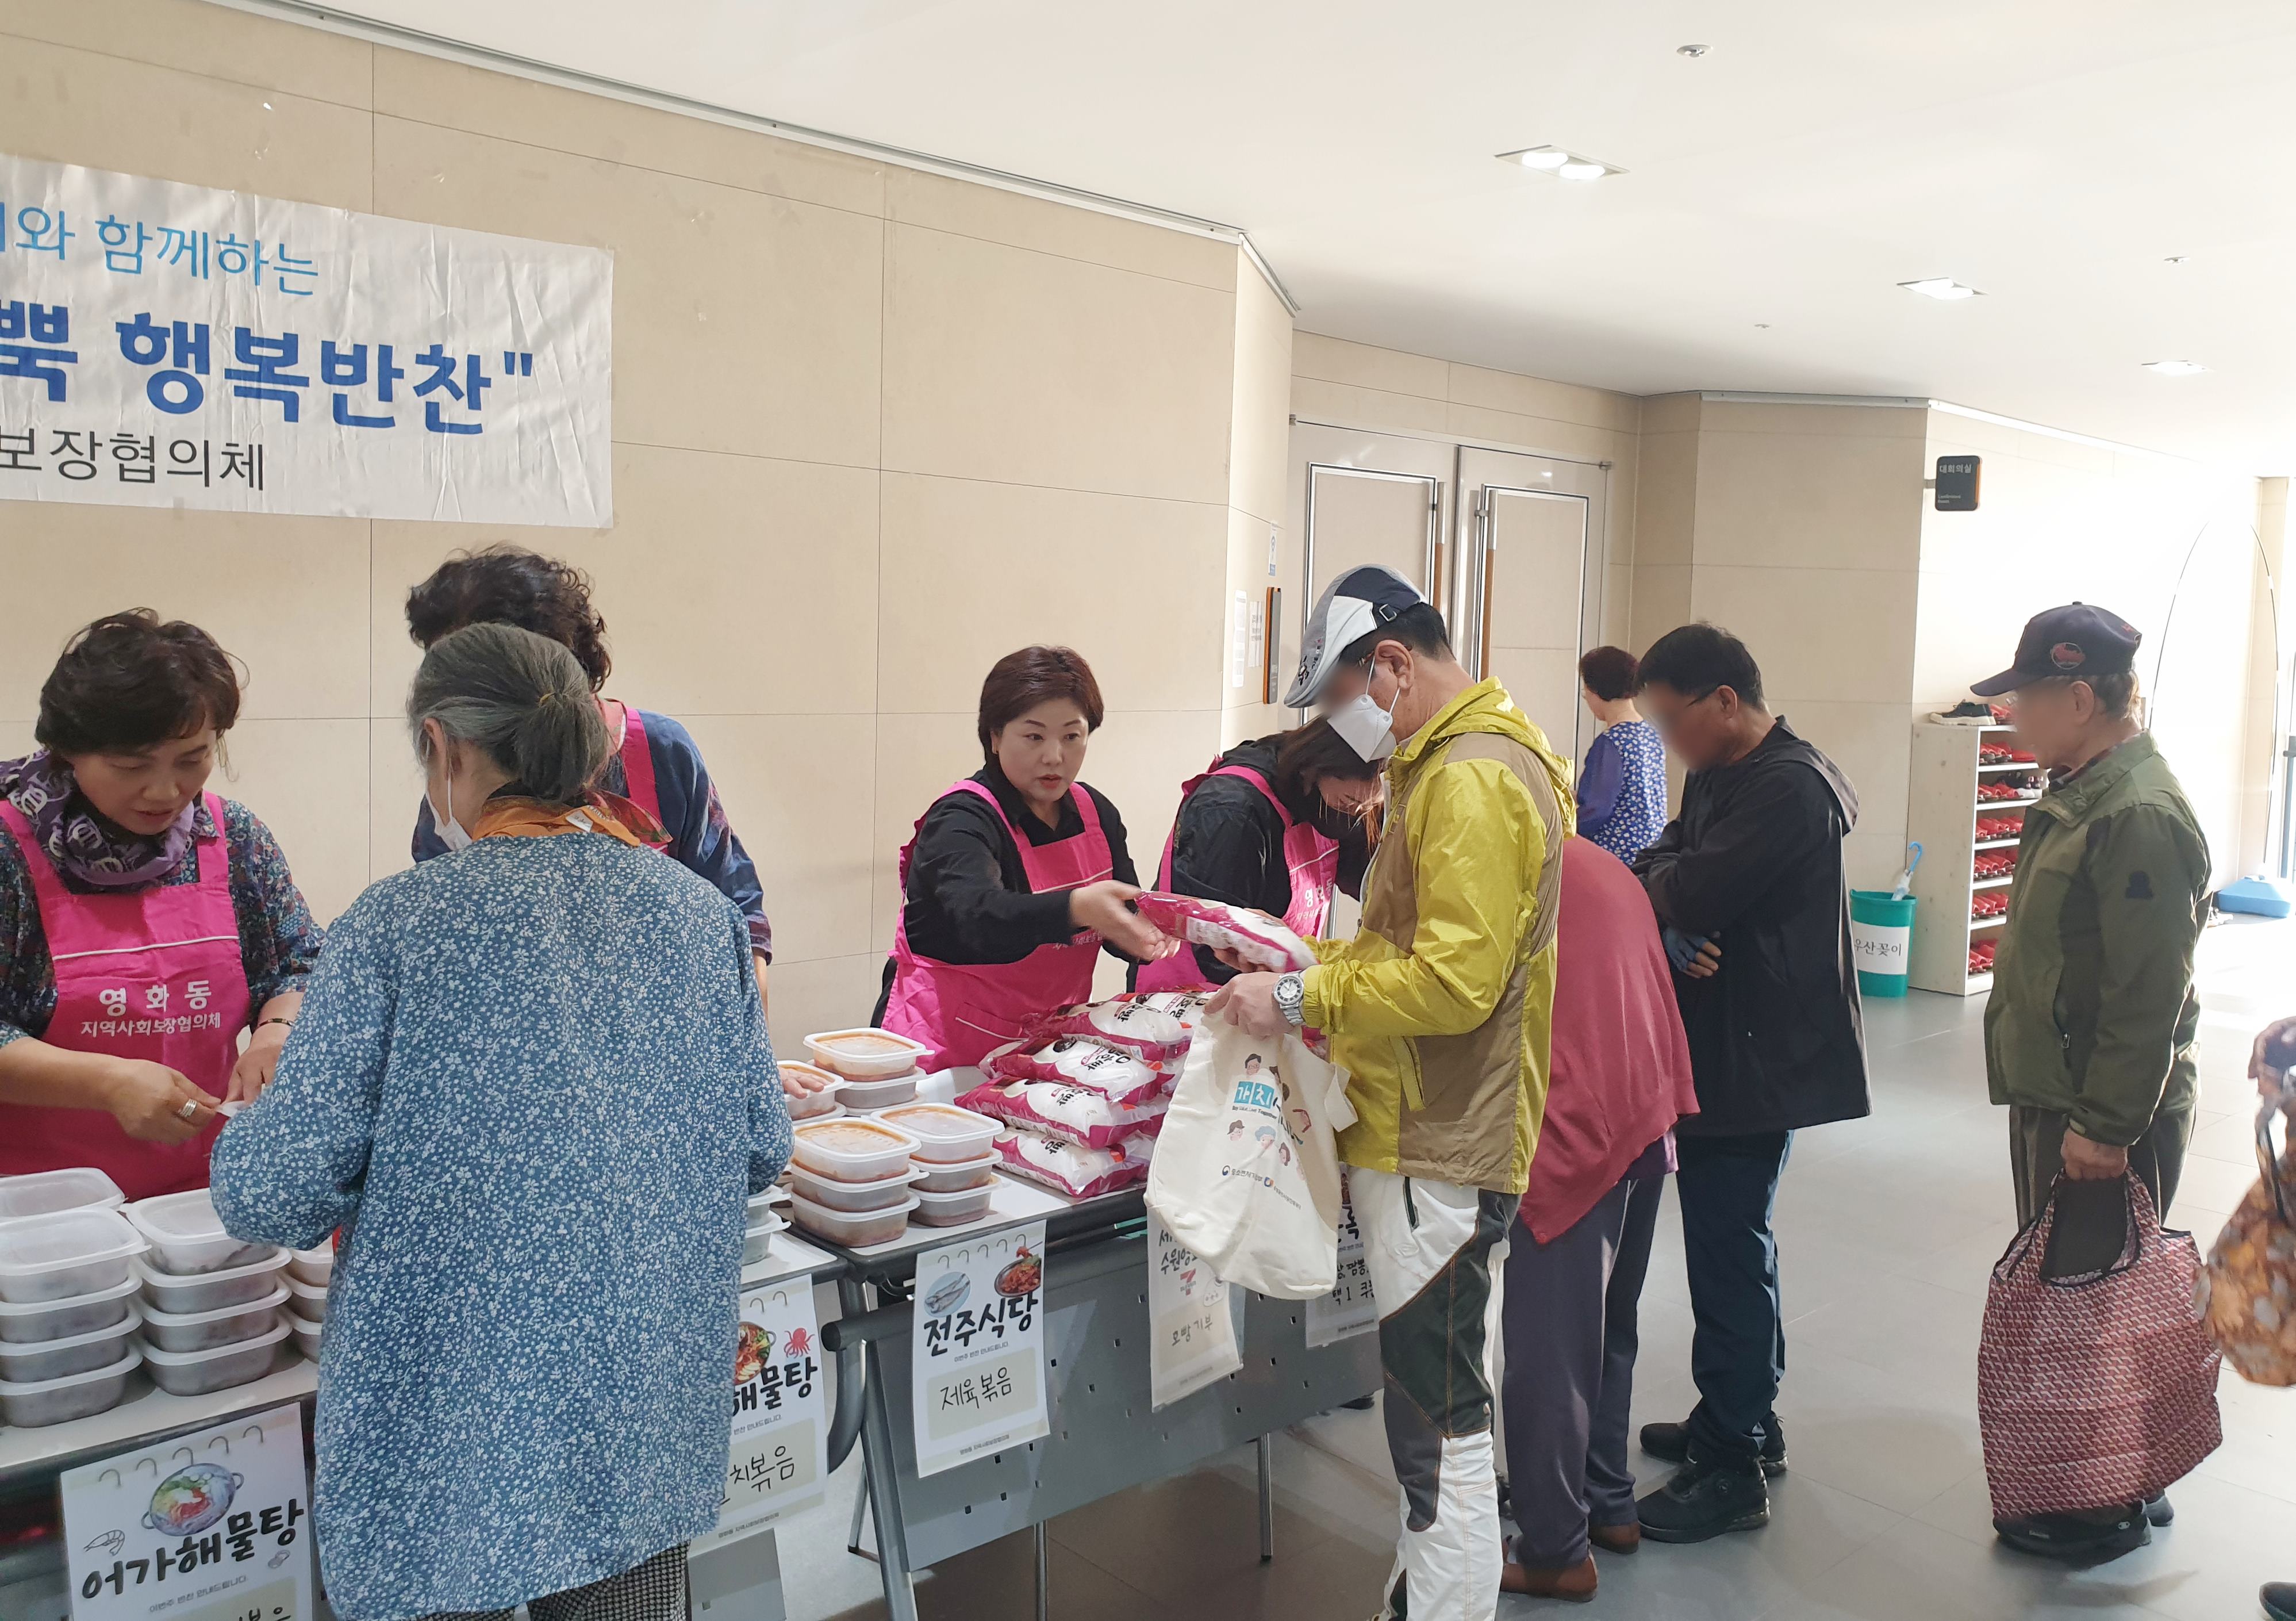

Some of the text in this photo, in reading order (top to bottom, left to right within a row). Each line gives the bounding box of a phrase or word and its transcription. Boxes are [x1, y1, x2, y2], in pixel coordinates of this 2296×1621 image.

[0, 202, 319, 296] 와 함께하는
[116, 312, 533, 434] 행복반찬"
[0, 426, 264, 491] 보장협의체
[80, 1012, 221, 1038] 지역사회보장협의체
[924, 1289, 1039, 1357] 전주식당
[1193, 1313, 1213, 1331] 기부
[940, 1367, 1012, 1411] 제육볶음
[82, 1499, 305, 1599] 어가해물탕
